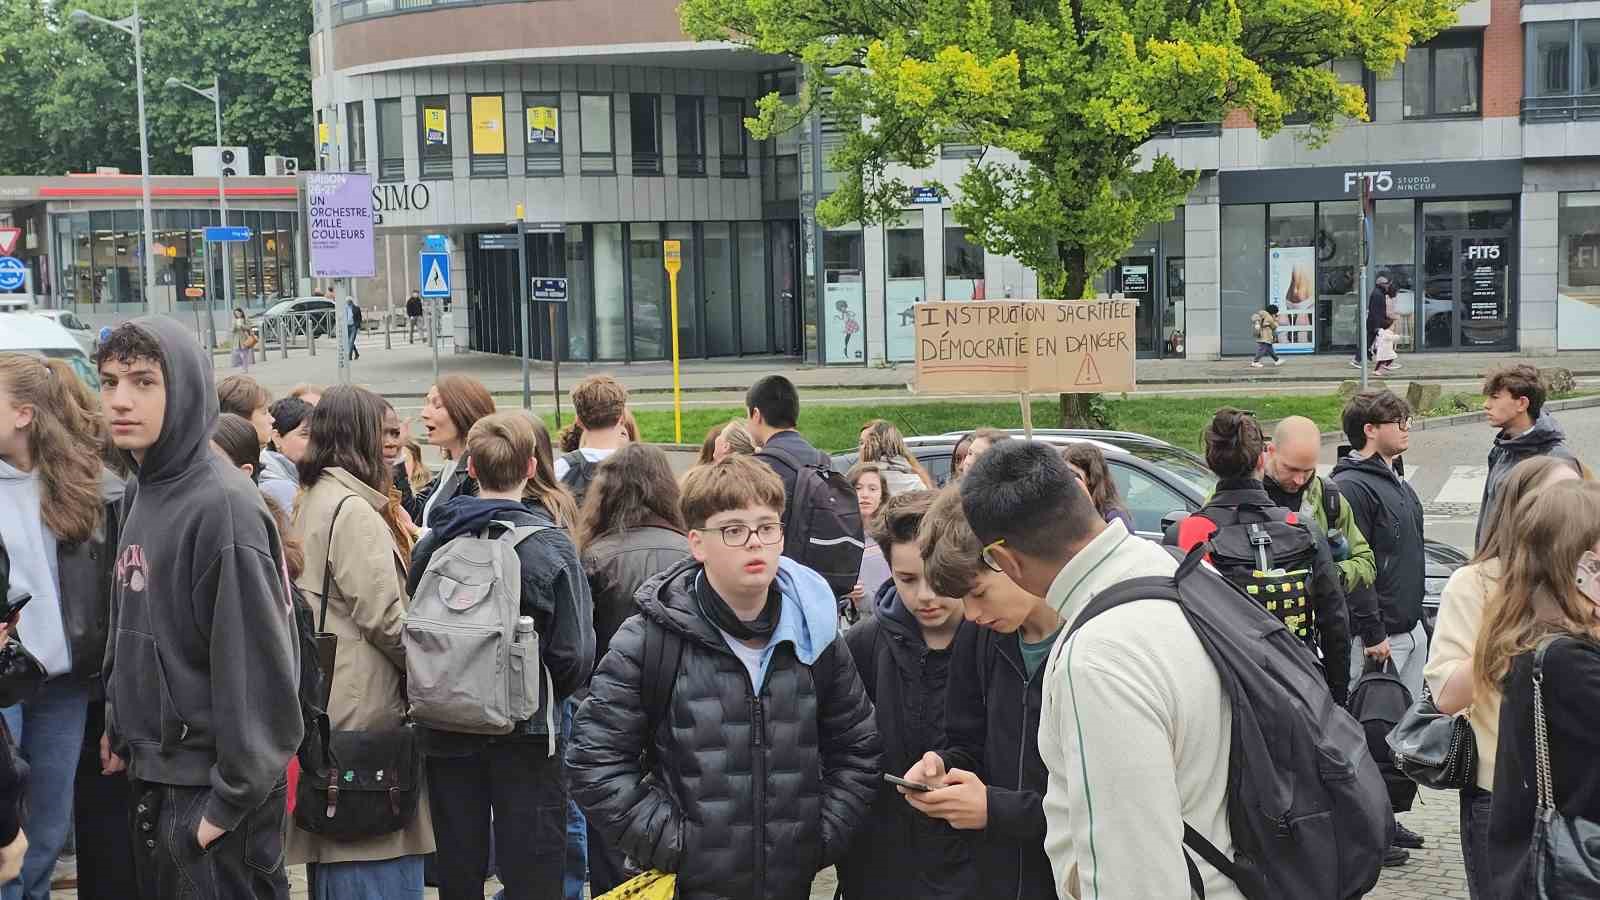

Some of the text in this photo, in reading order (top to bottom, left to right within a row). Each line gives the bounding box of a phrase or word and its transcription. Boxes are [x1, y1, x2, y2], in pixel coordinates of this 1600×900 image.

[1344, 170, 1393, 193] FT5
[1397, 176, 1430, 184] STUDIO
[310, 195, 325, 206] UN
[310, 207, 371, 218] ORCHESTRE,
[311, 218, 342, 228] MILLE
[311, 229, 365, 240] COULEURS
[1467, 245, 1501, 259] FIT5
[1036, 337, 1057, 357] EN
[1066, 332, 1130, 353] DANGER
